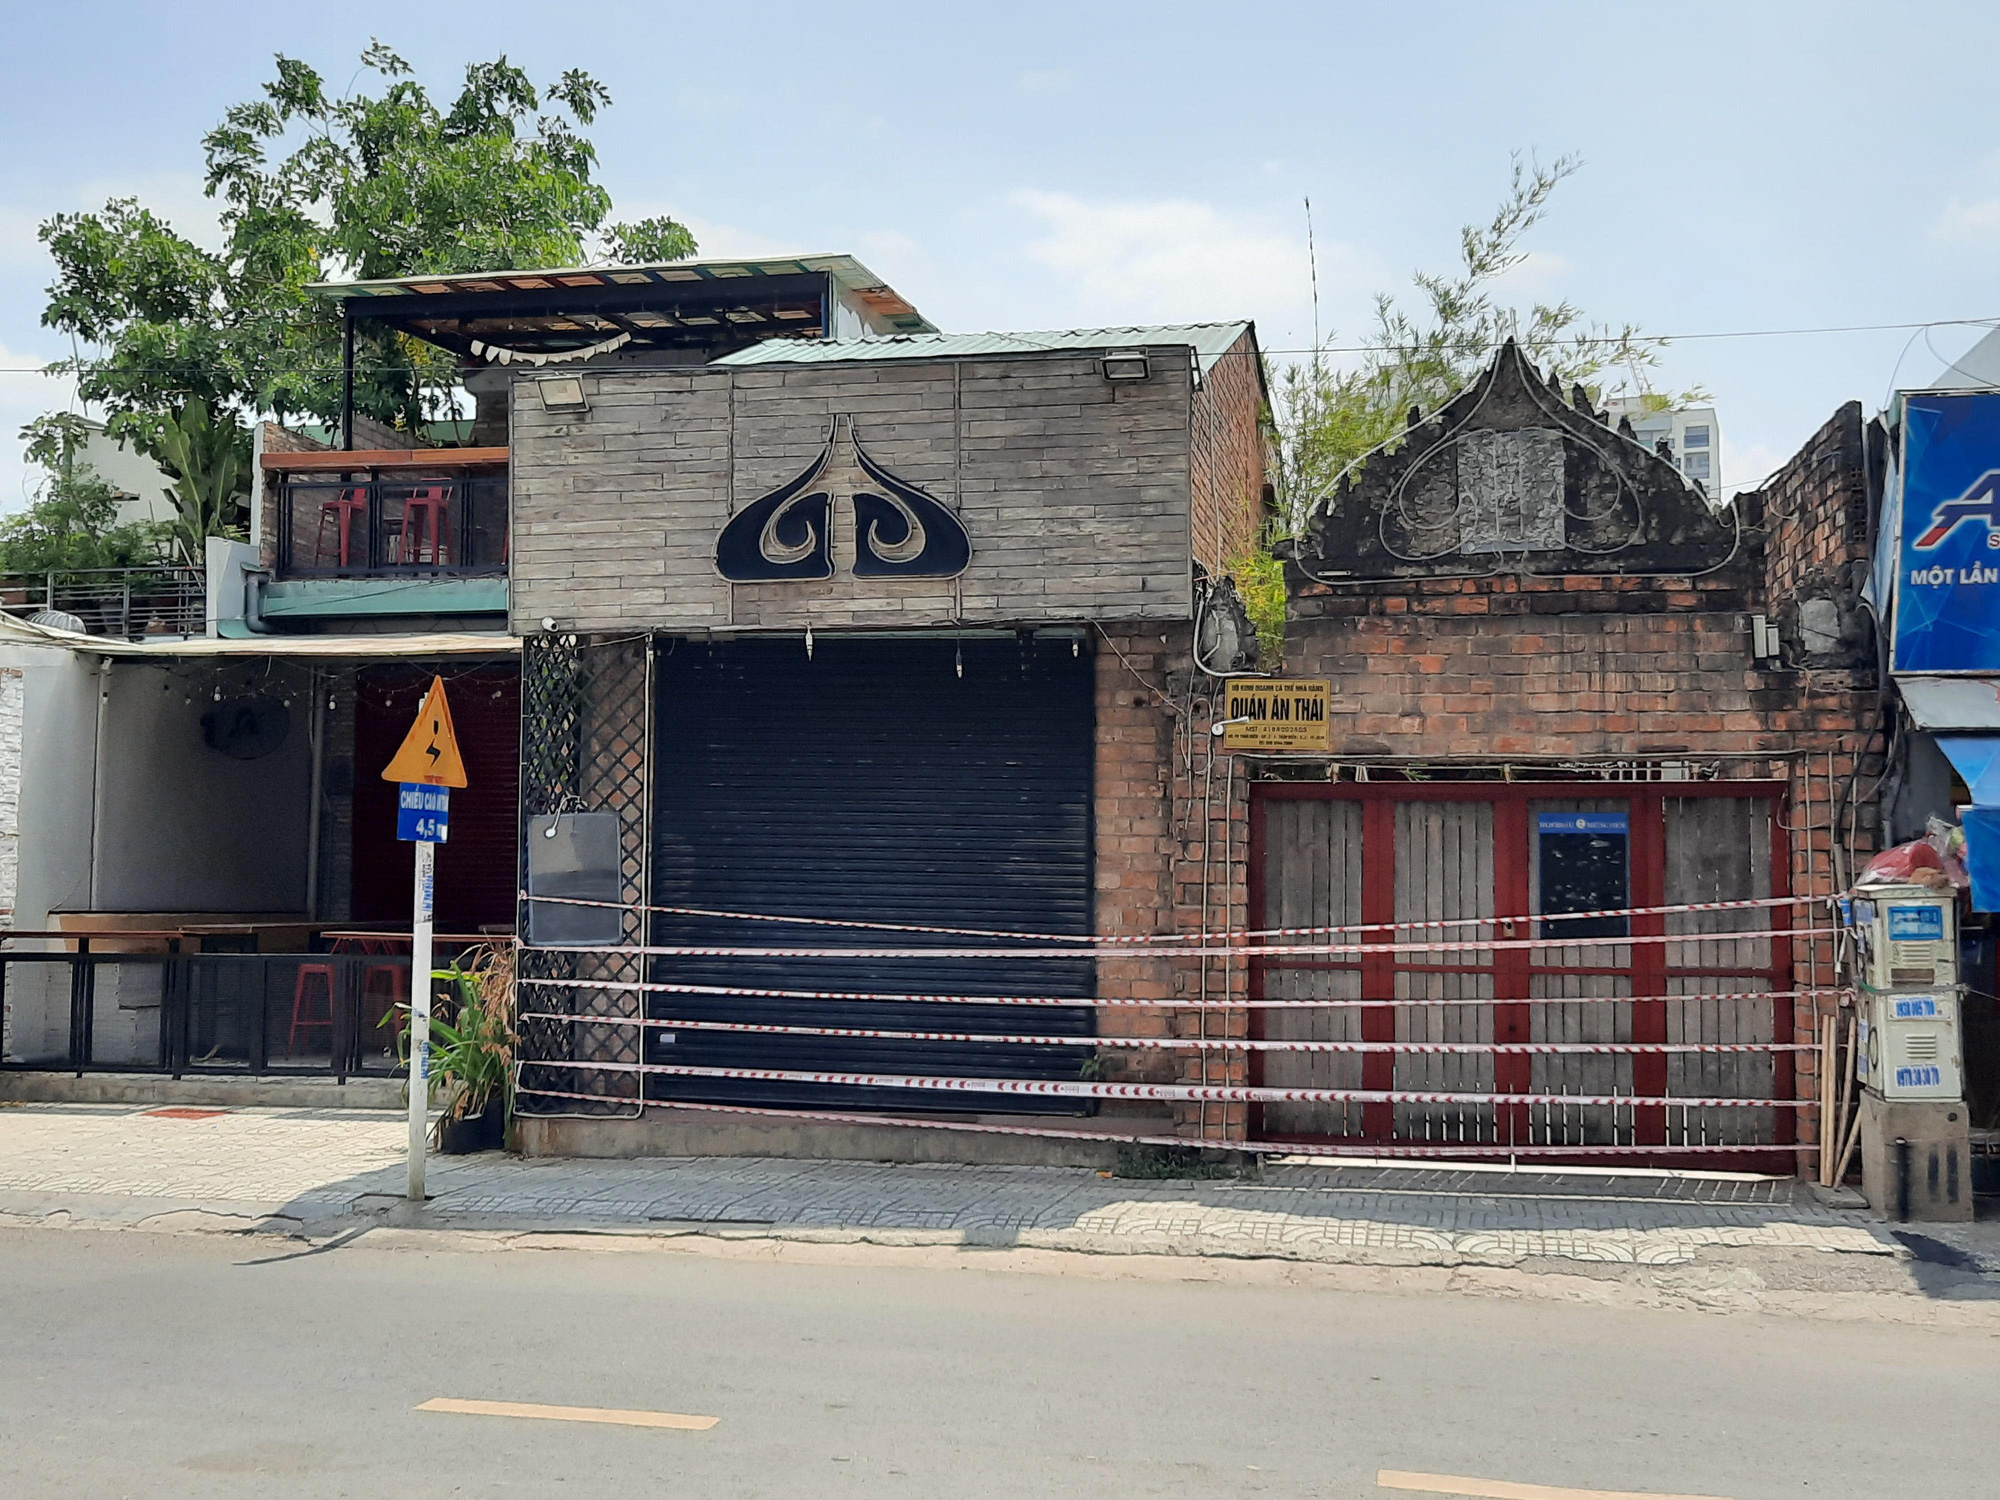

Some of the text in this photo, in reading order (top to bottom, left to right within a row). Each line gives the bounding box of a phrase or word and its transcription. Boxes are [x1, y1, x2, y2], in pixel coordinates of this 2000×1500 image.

[1911, 565, 1954, 588] MỘT
[1271, 694, 1290, 720] ĂN
[1294, 694, 1324, 721] THÁI
[415, 818, 435, 839] 4,5
